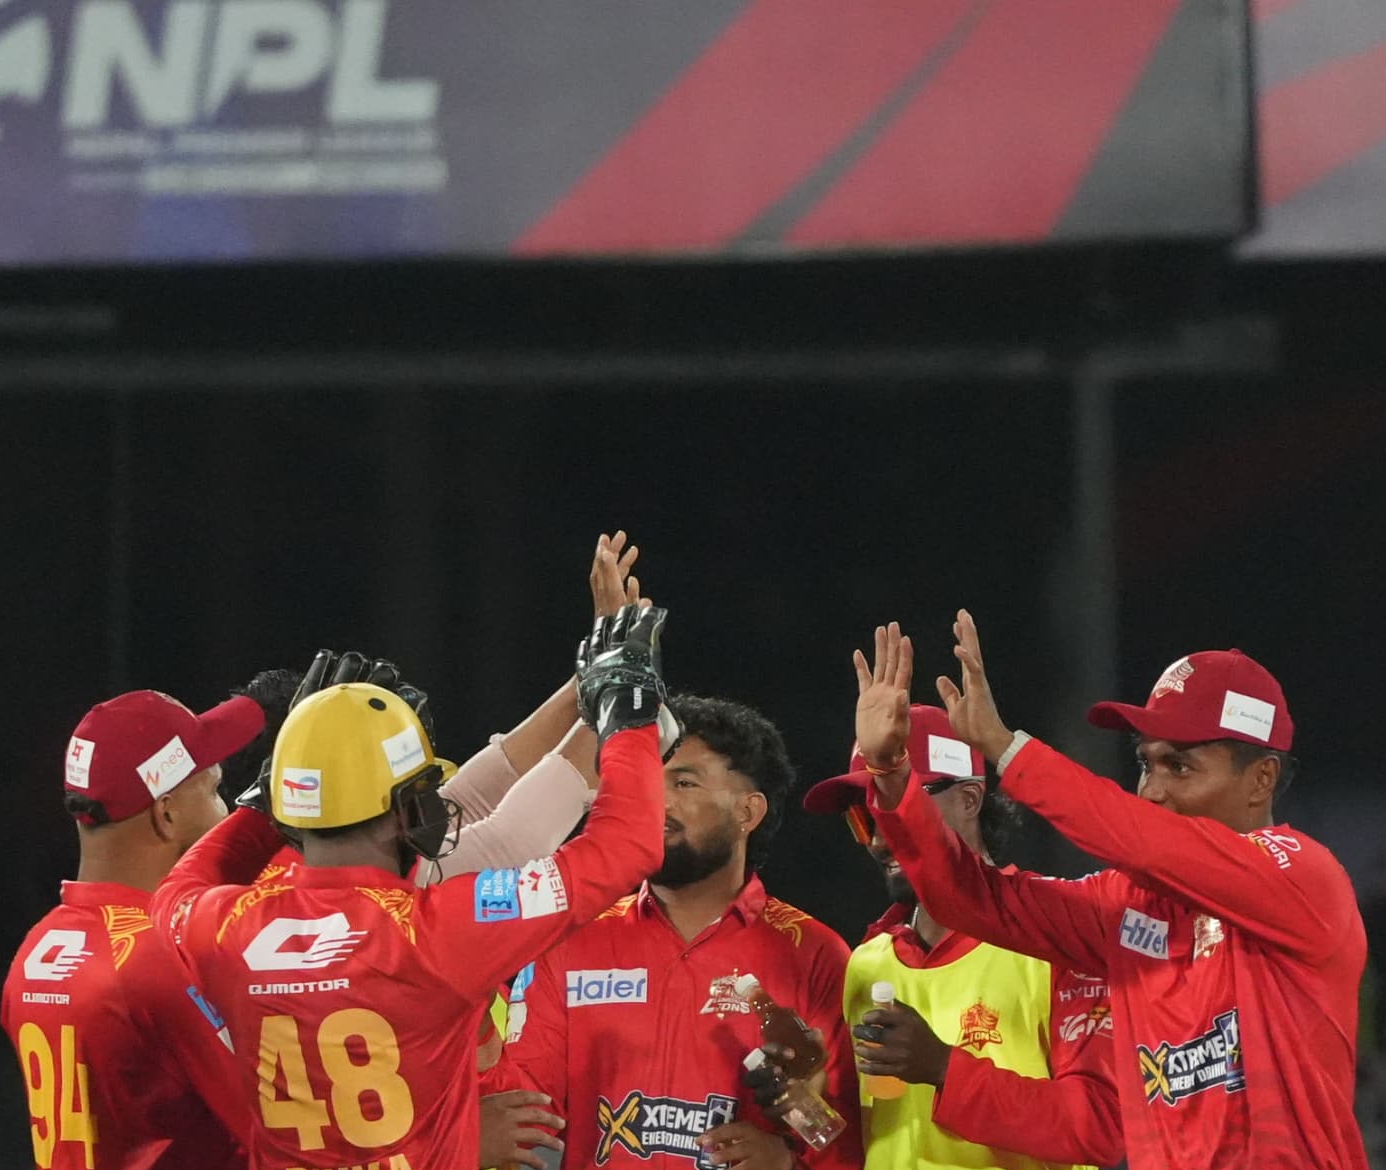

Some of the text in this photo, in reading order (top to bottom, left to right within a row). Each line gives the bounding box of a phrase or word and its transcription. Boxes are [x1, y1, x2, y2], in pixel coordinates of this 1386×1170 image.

[62, 0, 440, 128] NPL
[248, 977, 351, 997] QJMOTOR
[566, 971, 647, 1002] Haier
[18, 1021, 99, 1170] 94
[255, 1007, 415, 1151] 48
